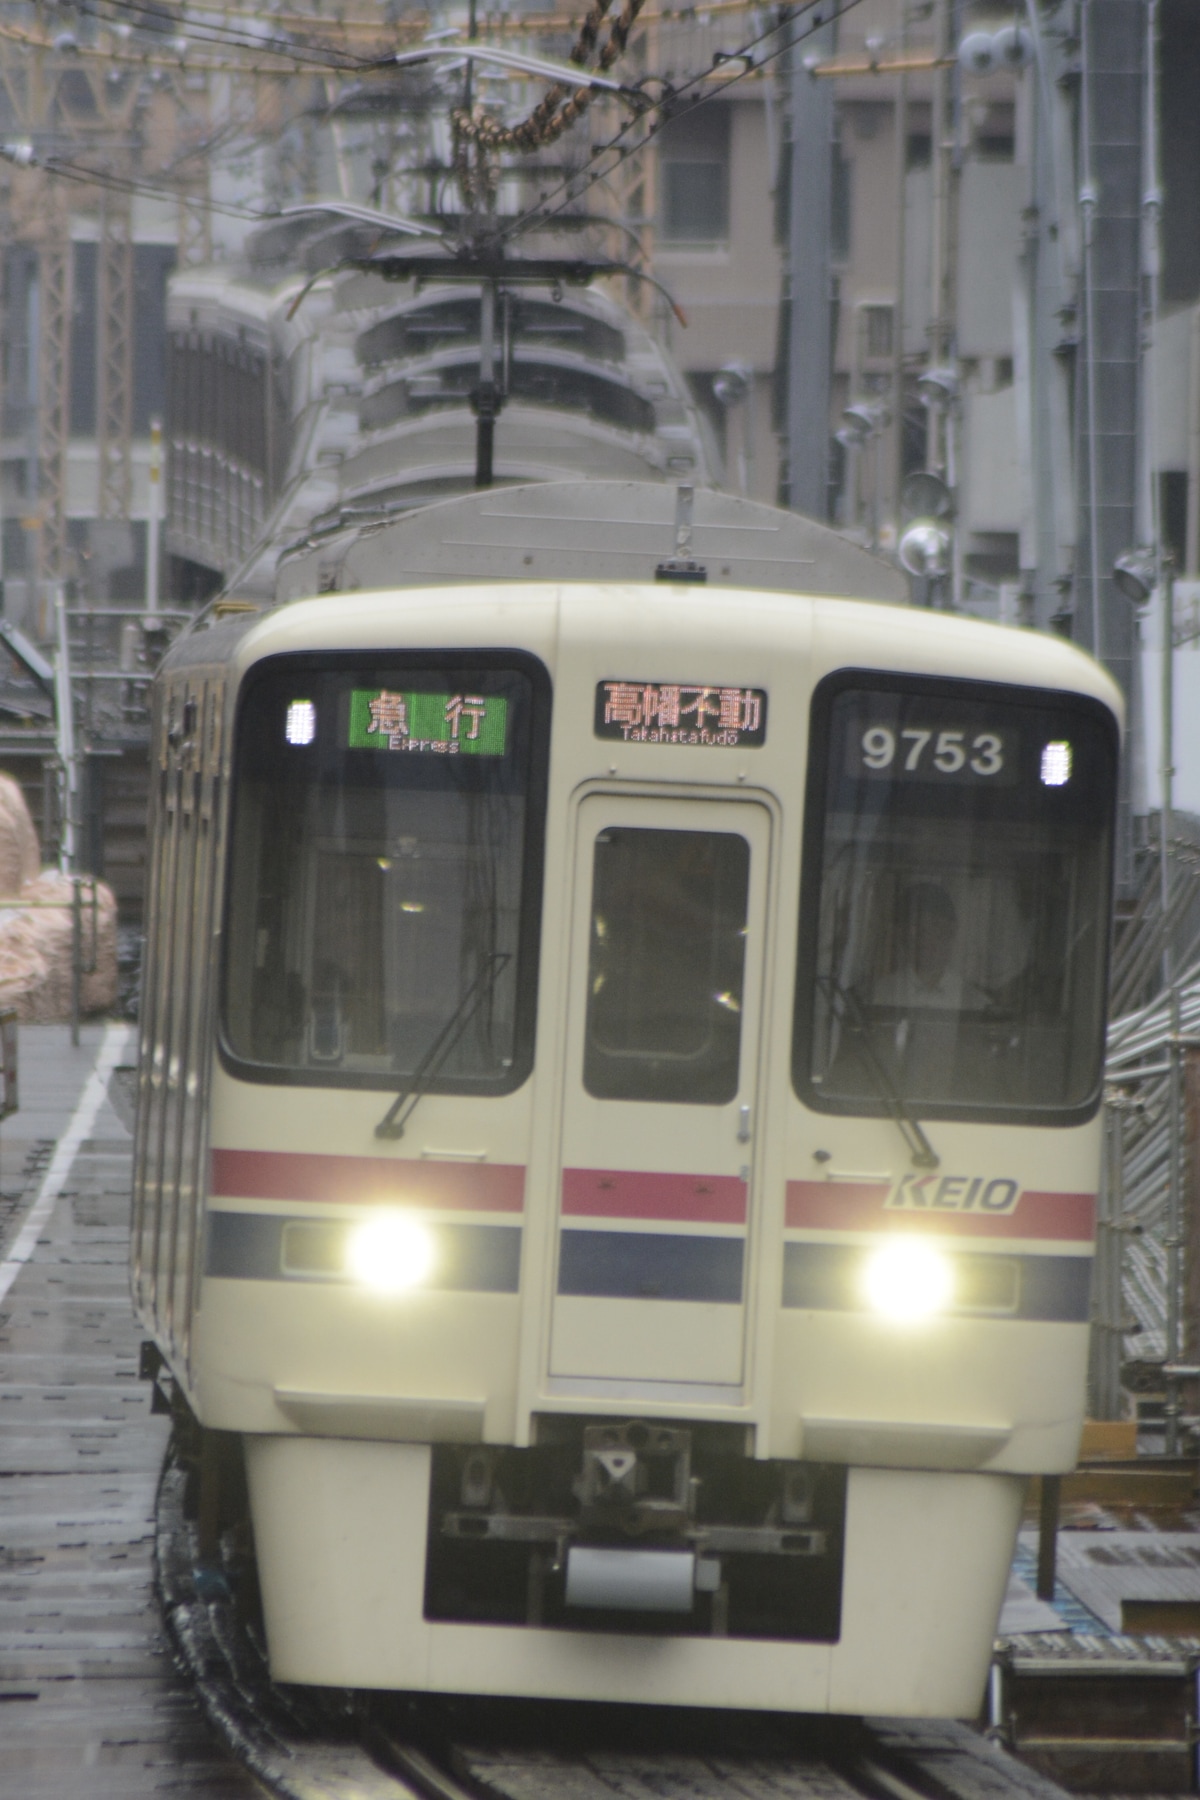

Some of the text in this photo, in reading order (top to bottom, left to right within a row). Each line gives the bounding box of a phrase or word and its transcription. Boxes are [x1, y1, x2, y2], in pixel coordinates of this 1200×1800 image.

[366, 689, 486, 740] 急行
[603, 682, 761, 732] 高幡不動
[388, 735, 461, 754] Express
[861, 726, 1003, 776] 9753
[891, 1173, 1020, 1211] KEIO
